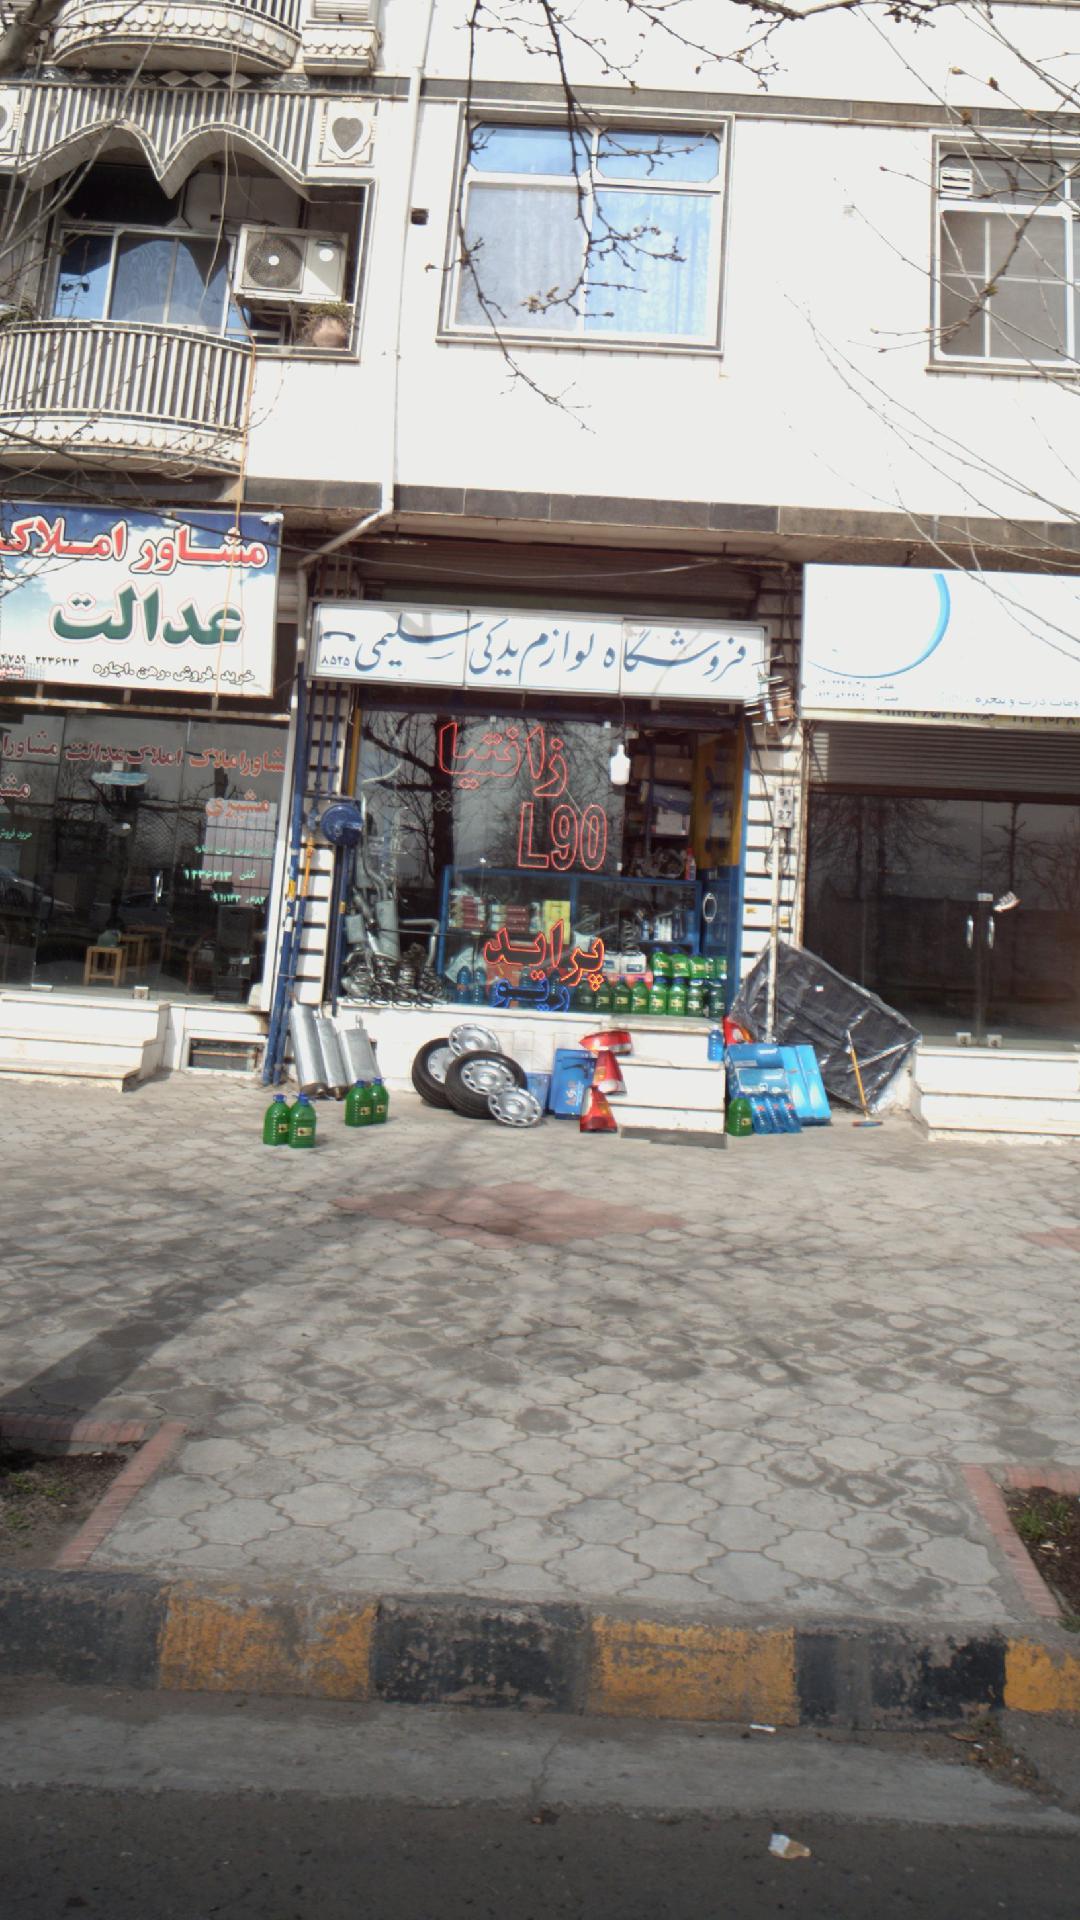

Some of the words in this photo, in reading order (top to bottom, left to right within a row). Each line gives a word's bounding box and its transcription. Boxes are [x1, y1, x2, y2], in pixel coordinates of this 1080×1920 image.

[0, 515, 128, 561] املاک
[129, 525, 268, 575] مشاور
[52, 583, 243, 647] عدالت
[469, 617, 519, 678] یدکی
[519, 629, 596, 685] لوازم
[604, 626, 746, 683] فروشگاه
[439, 722, 568, 797] زانتیا
[517, 801, 608, 871] L90
[484, 918, 605, 992] پراید
